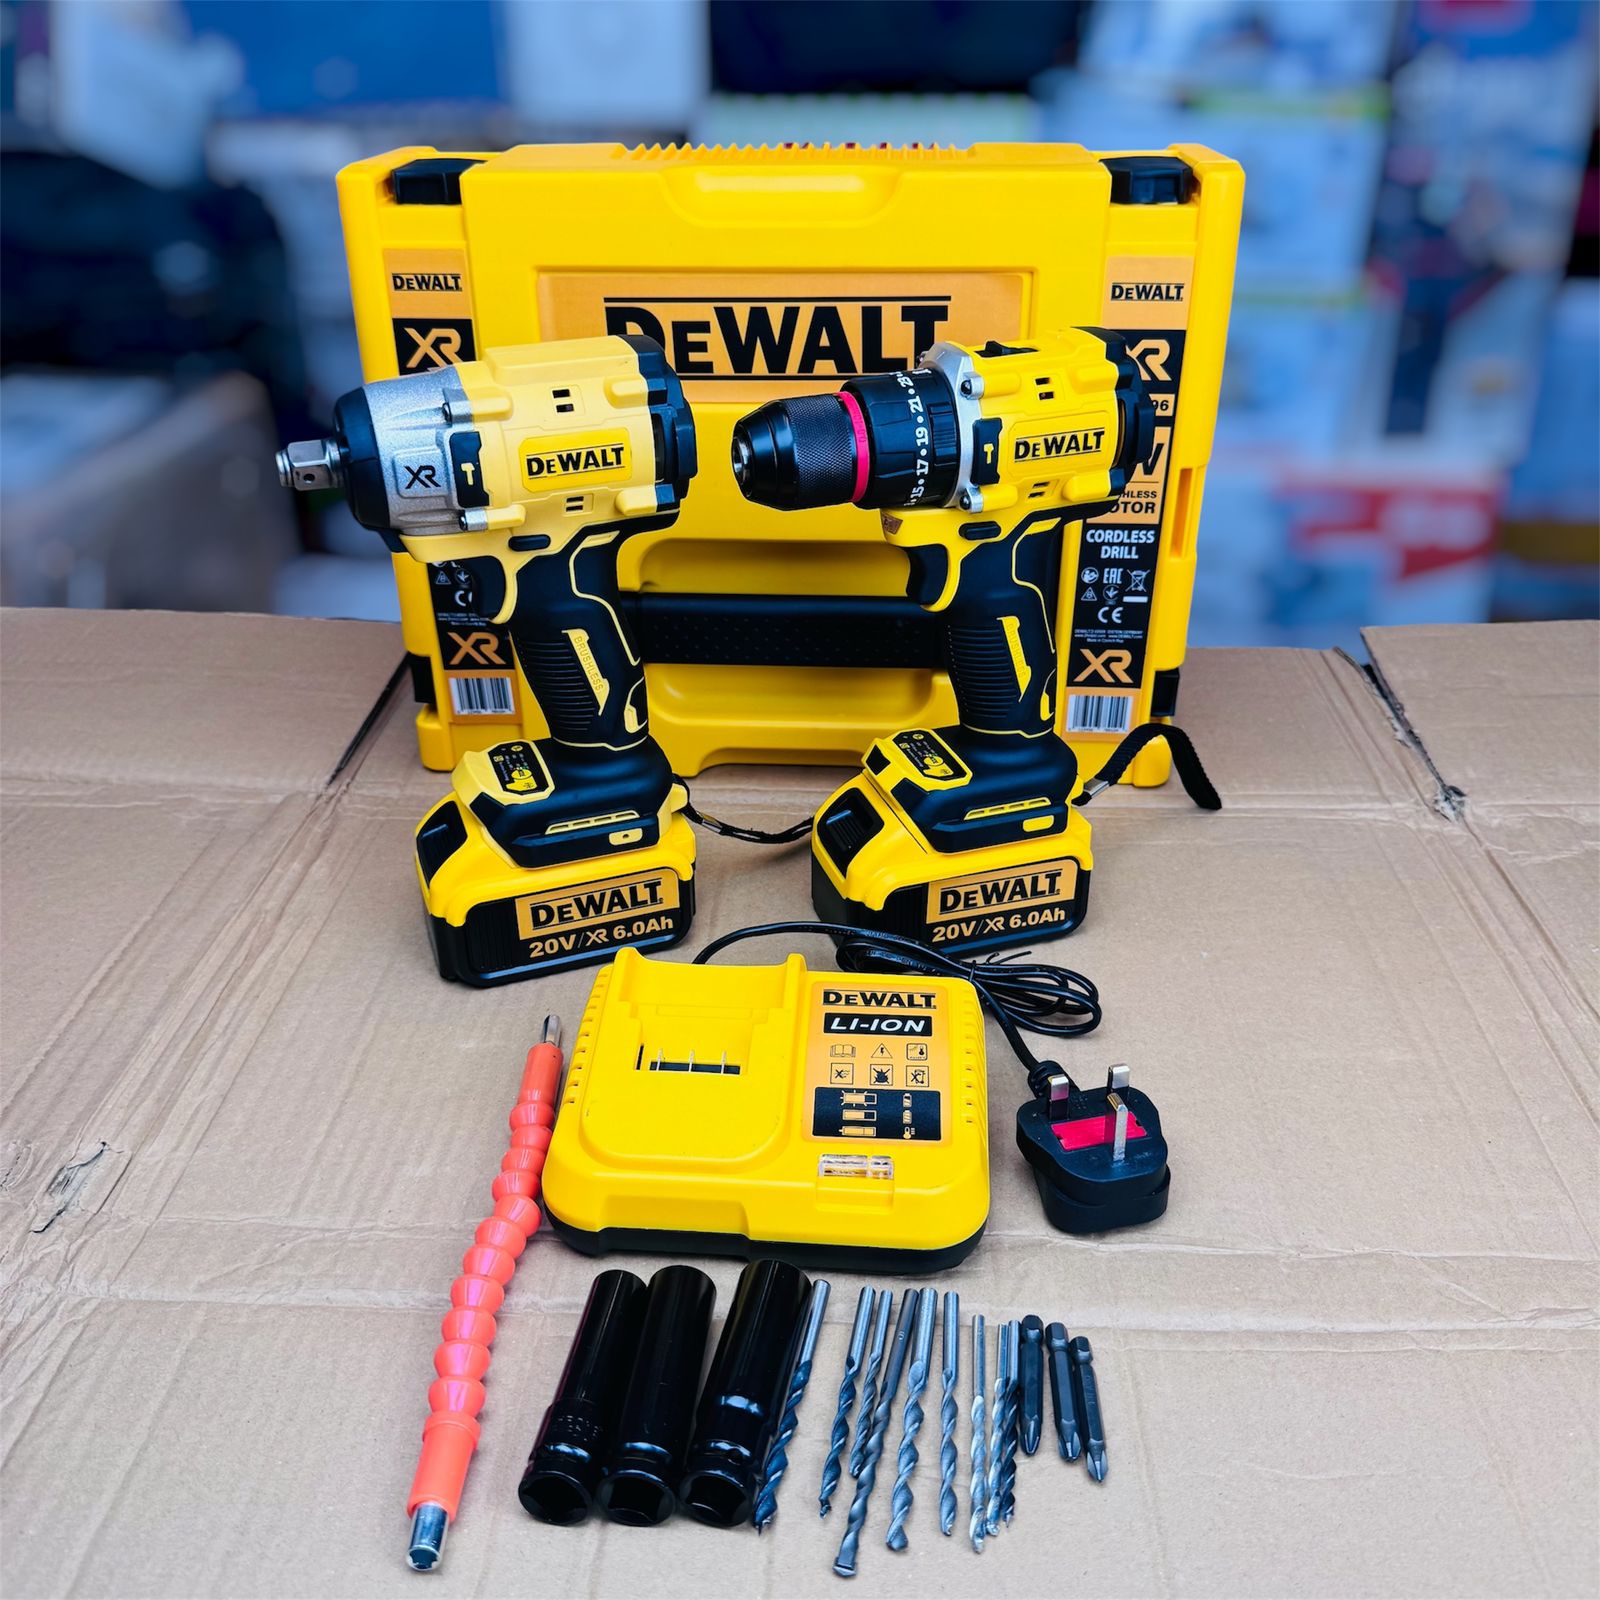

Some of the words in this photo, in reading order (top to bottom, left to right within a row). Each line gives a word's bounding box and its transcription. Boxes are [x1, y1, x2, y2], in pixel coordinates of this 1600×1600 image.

[391, 275, 462, 291] DEWALT
[1111, 284, 1185, 300] DEWALT
[404, 327, 464, 368] XR
[605, 305, 949, 374] DEWALT
[1152, 400, 1169, 411] 96
[915, 427, 928, 446] 19
[1014, 430, 1105, 460] DEWALT
[526, 447, 624, 477] DEWALT
[917, 459, 929, 476] 17
[404, 465, 441, 490] XR
[1123, 490, 1157, 498] HLESS
[1111, 502, 1155, 514] OTOR
[1086, 529, 1155, 544] CORDLESS
[1100, 545, 1139, 559] DRILL
[447, 631, 507, 665] XR
[573, 635, 605, 692] BRUSHLESS
[1073, 648, 1134, 683] XR
[939, 871, 1062, 913] DEWALT
[530, 880, 662, 929] DEWALT
[612, 916, 674, 940] 6.0Ah
[1009, 907, 1066, 929] 6.0Ah
[822, 990, 936, 1008] DEWALT
[830, 1017, 925, 1033] LI-ION
